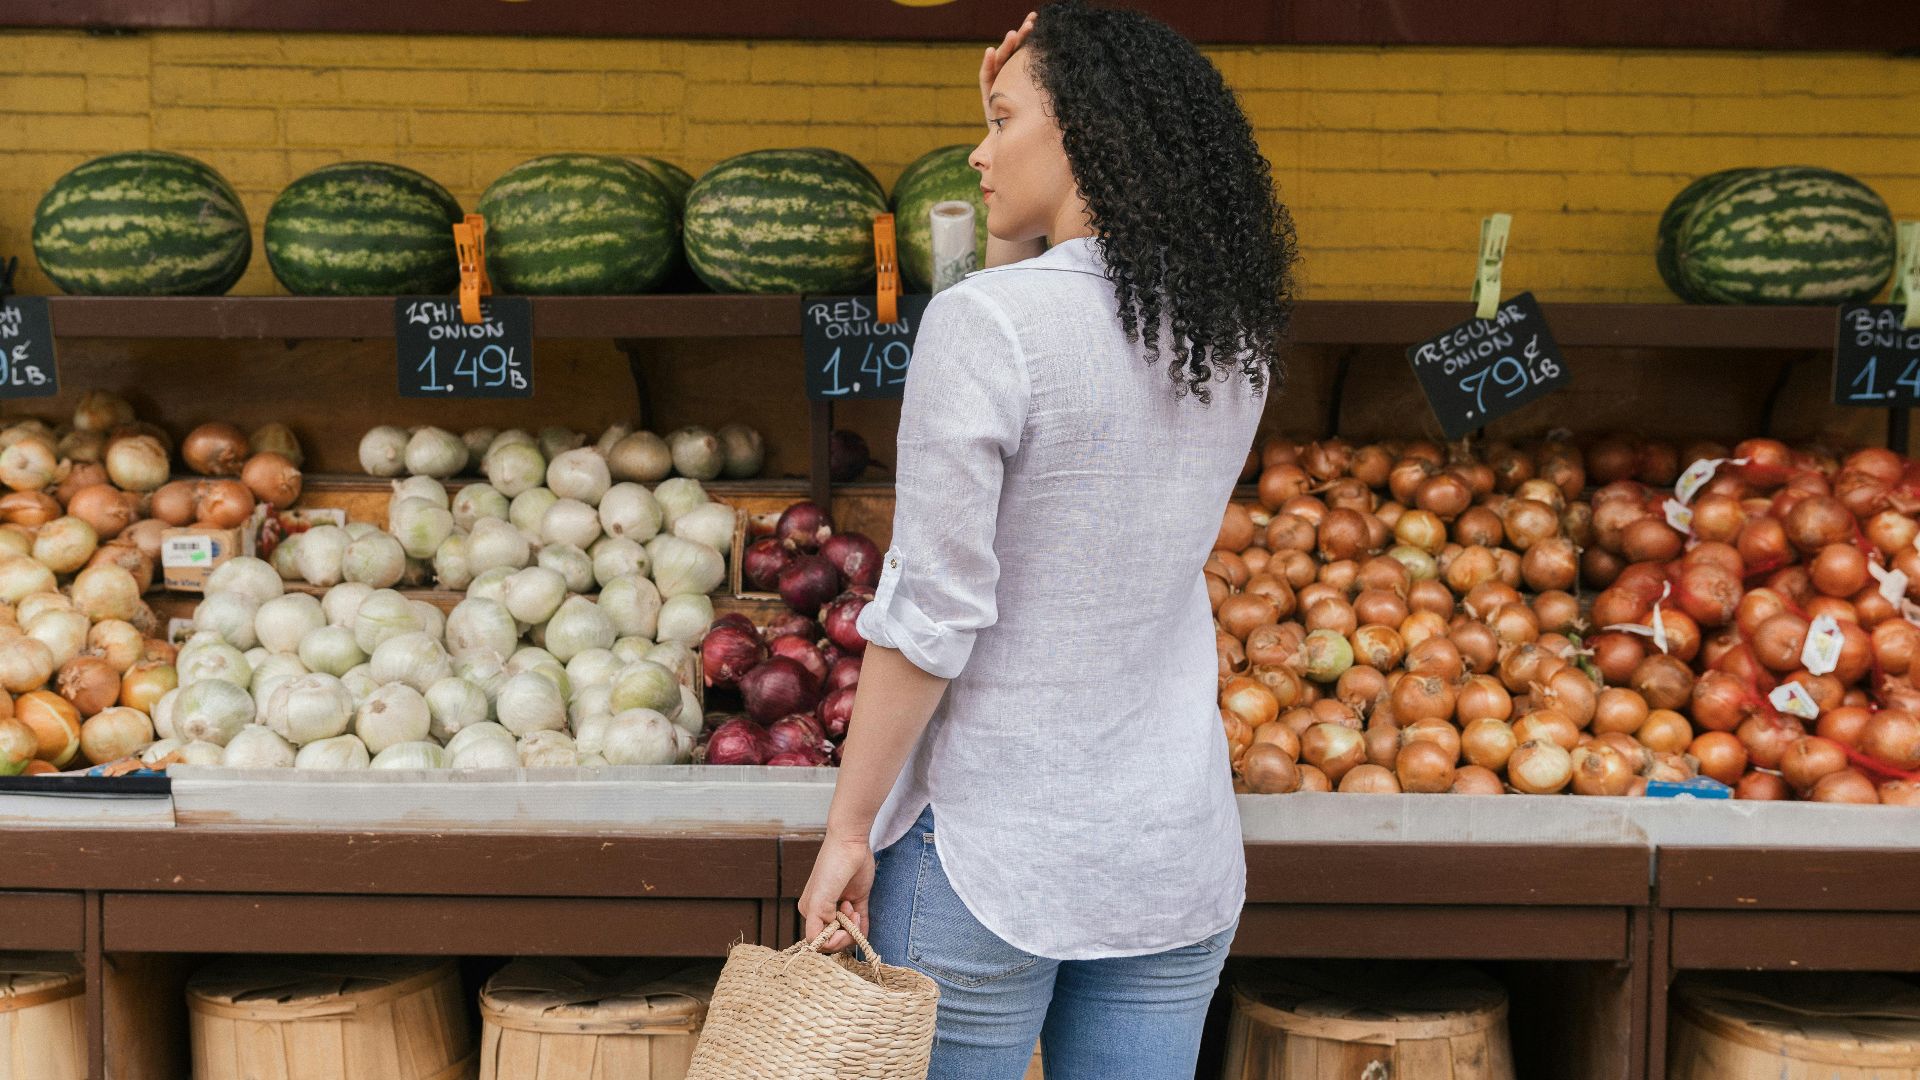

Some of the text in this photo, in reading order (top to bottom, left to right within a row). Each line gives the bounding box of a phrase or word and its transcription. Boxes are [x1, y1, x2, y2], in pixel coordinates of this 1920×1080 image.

[808, 298, 871, 325] RED
[825, 317, 909, 339] ONION
[428, 321, 504, 339] ONION
[1415, 304, 1527, 366] REGULAR
[417, 344, 507, 391] 1.49
[821, 341, 911, 395] 1.49
[1443, 331, 1513, 375] ONION
[1530, 358, 1560, 385] LB
